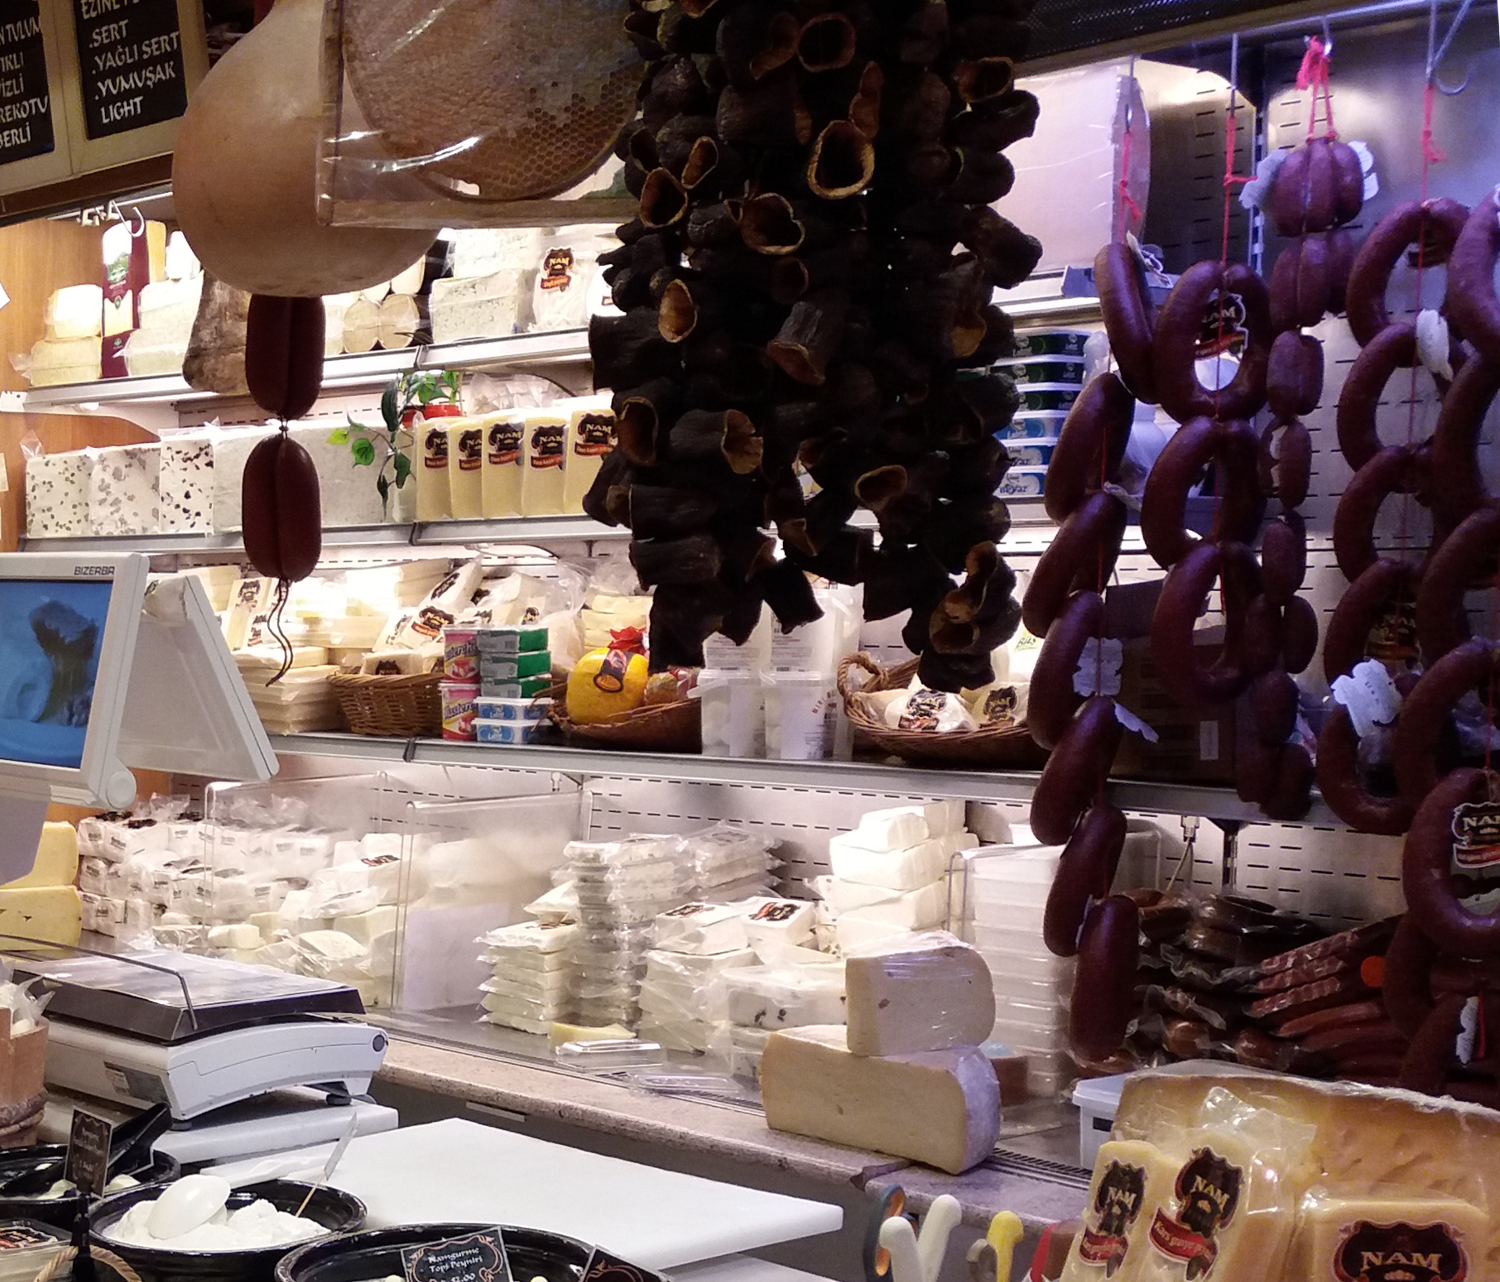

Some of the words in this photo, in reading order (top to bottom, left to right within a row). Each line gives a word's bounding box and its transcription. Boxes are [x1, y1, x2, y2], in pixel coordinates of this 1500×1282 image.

[141, 31, 180, 59] SERT
[100, 96, 144, 124] LIGHT
[550, 257, 570, 266] NAM
[496, 430, 522, 441] NAM
[585, 423, 613, 433] NAM
[74, 566, 115, 575] BIZERBA
[423, 610, 449, 626] NAM
[1105, 1186, 1137, 1211] NAM
[1190, 1174, 1230, 1213] NAM
[428, 1247, 480, 1264] Namgurme
[450, 1255, 483, 1269] Peyniri
[1360, 1250, 1442, 1274] NAM
